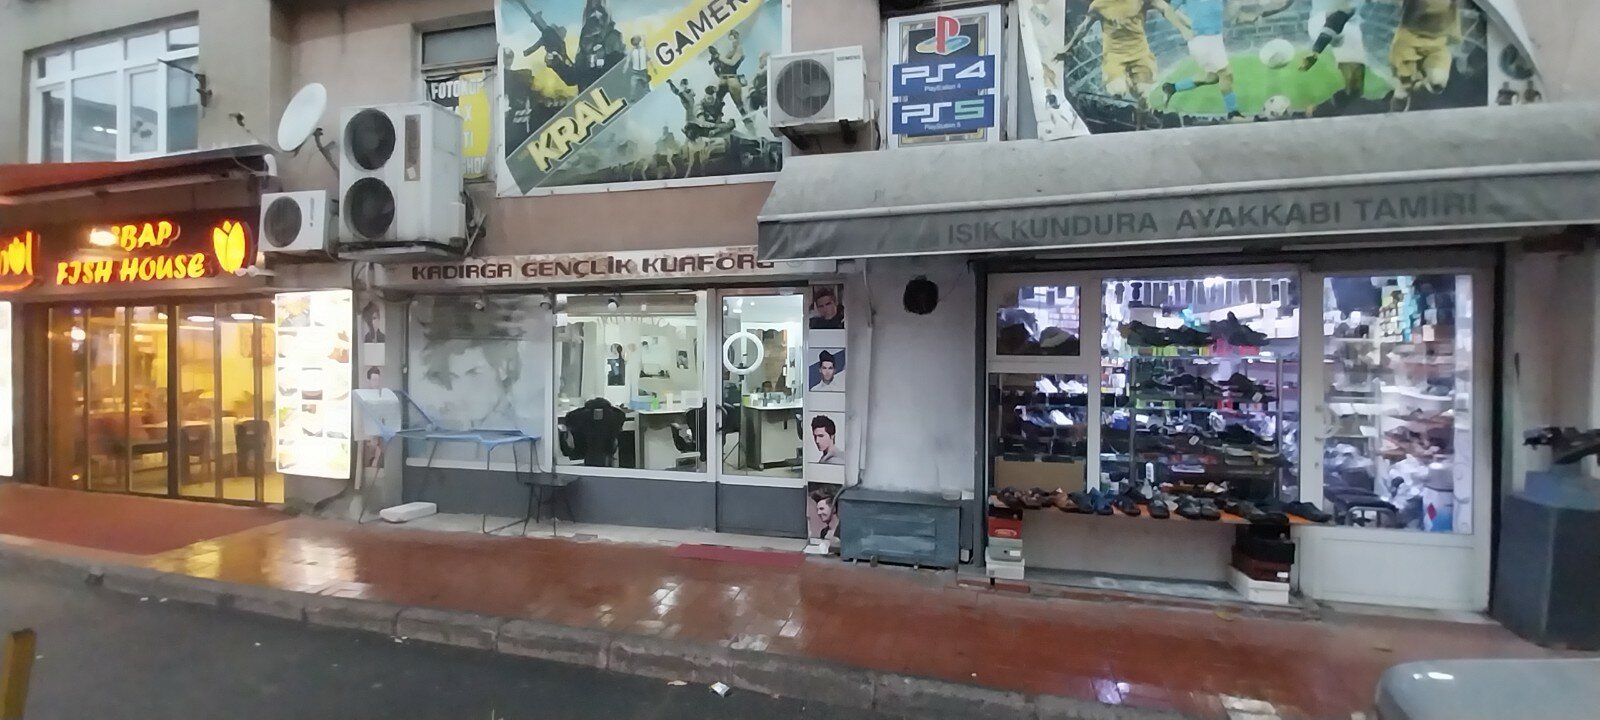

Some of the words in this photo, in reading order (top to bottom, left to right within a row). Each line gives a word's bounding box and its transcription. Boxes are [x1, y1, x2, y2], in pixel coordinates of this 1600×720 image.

[901, 60, 986, 86] PS4
[901, 99, 985, 124] PS5
[526, 87, 628, 173] KRAL
[1011, 212, 1158, 240] KUNDURA
[1176, 201, 1341, 231] AYAKKABI
[56, 258, 115, 286] FISH
[120, 252, 206, 282] HOUSE
[411, 262, 512, 281] KADIRGA
[521, 255, 632, 279] GENÇLİK
